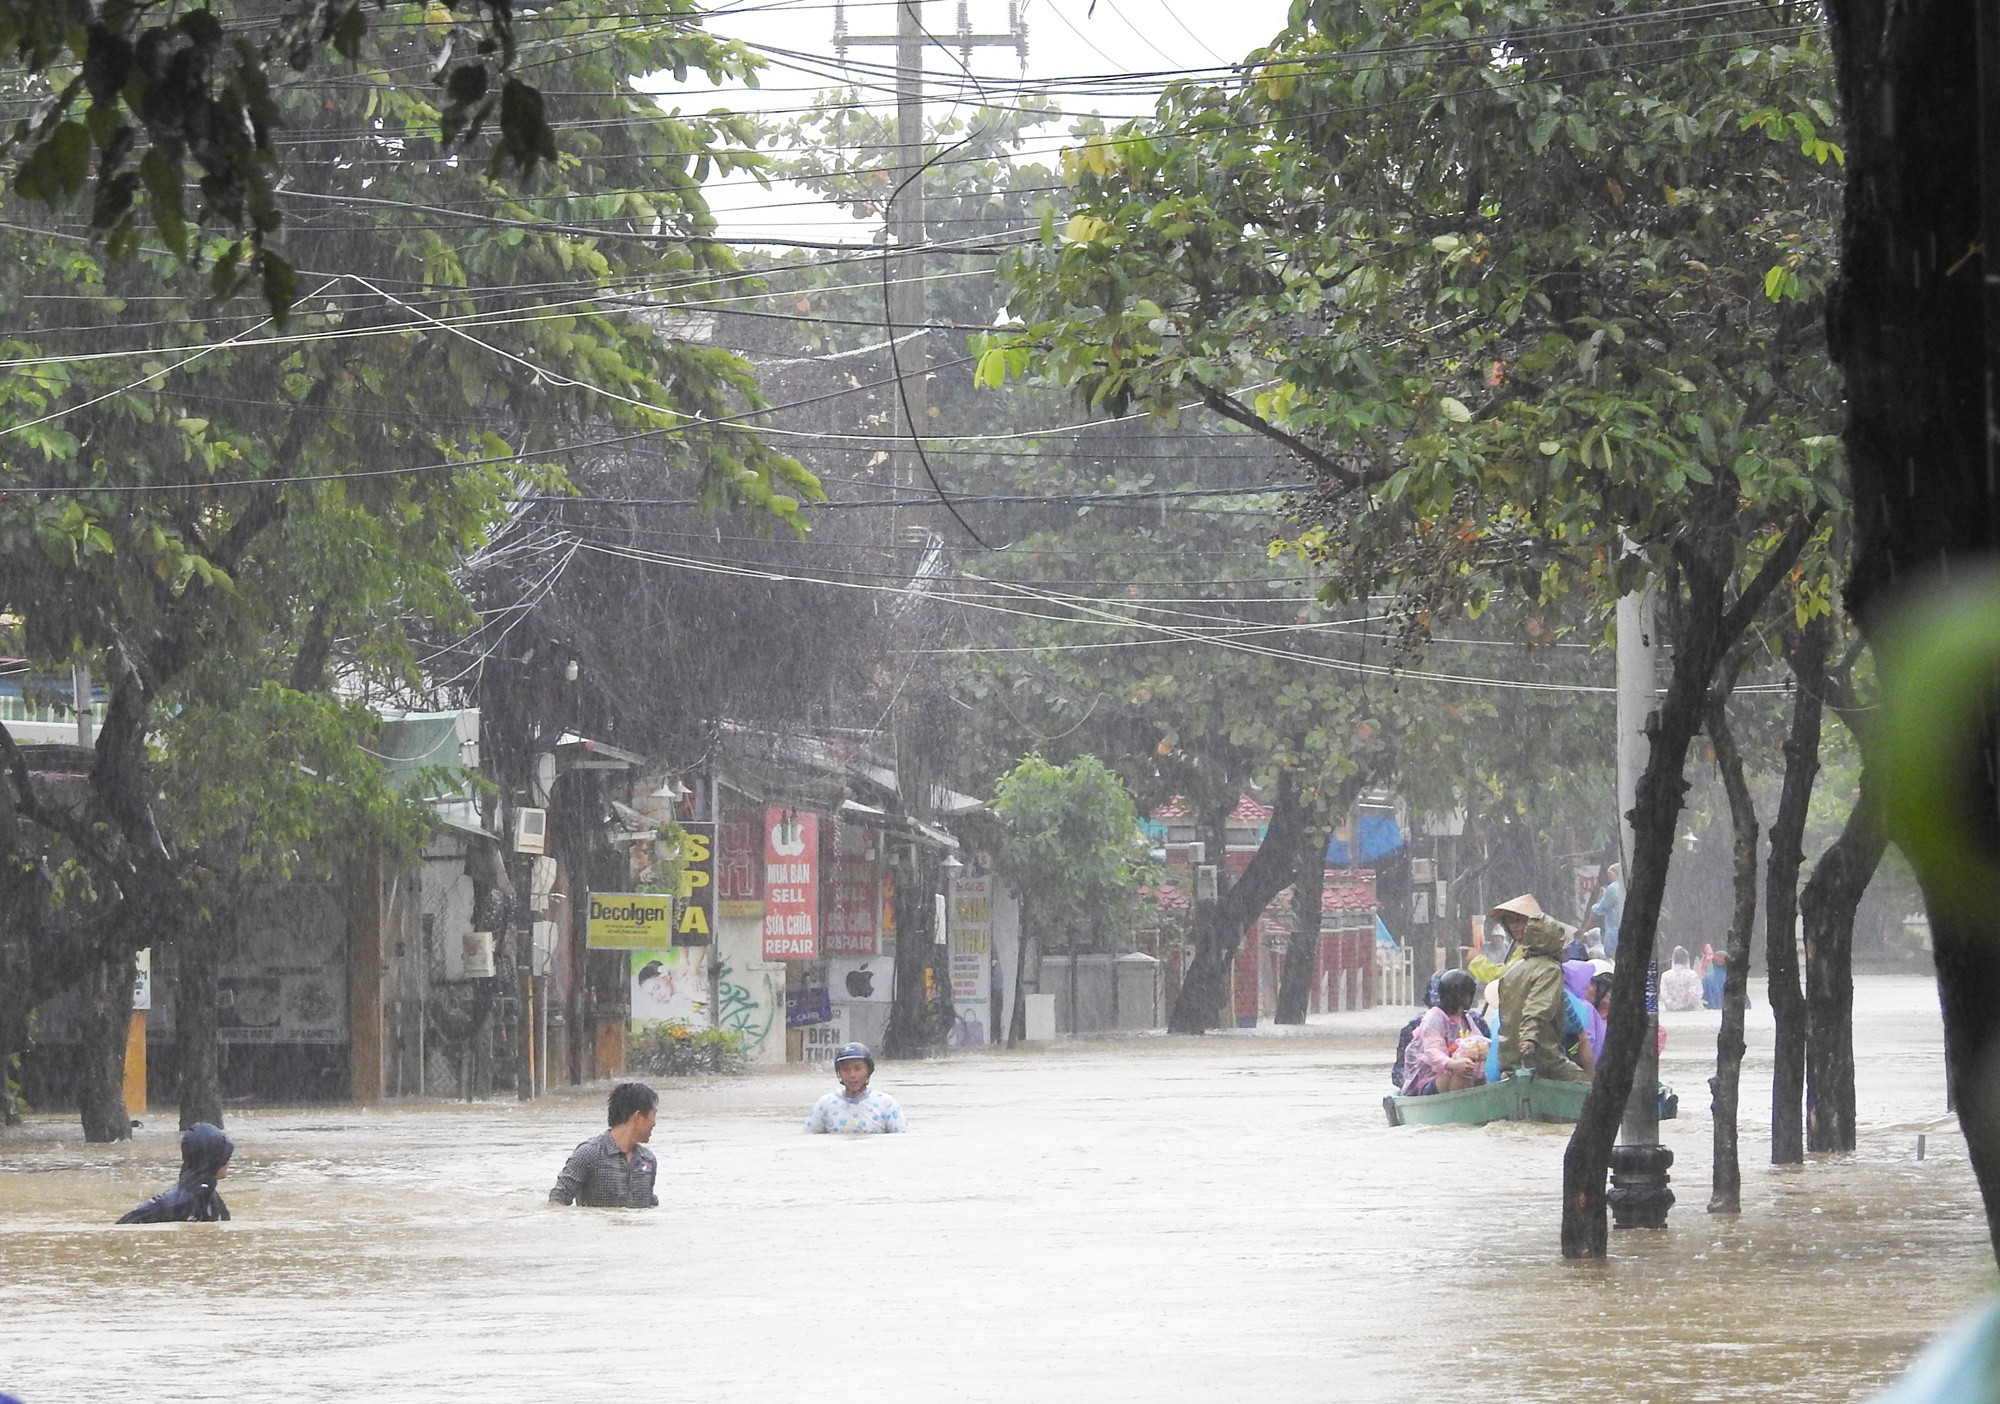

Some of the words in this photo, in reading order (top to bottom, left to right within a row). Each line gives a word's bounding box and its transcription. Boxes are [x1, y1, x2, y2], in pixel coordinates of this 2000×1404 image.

[679, 833, 711, 934] SPA
[767, 863, 789, 884] MUA
[772, 888, 806, 903] SELL
[590, 901, 665, 926] Decolgen
[765, 908, 785, 936] SỬA
[786, 911, 812, 936] CHỮA
[765, 939, 814, 954] REPAIR
[826, 935, 873, 951] REPAIR
